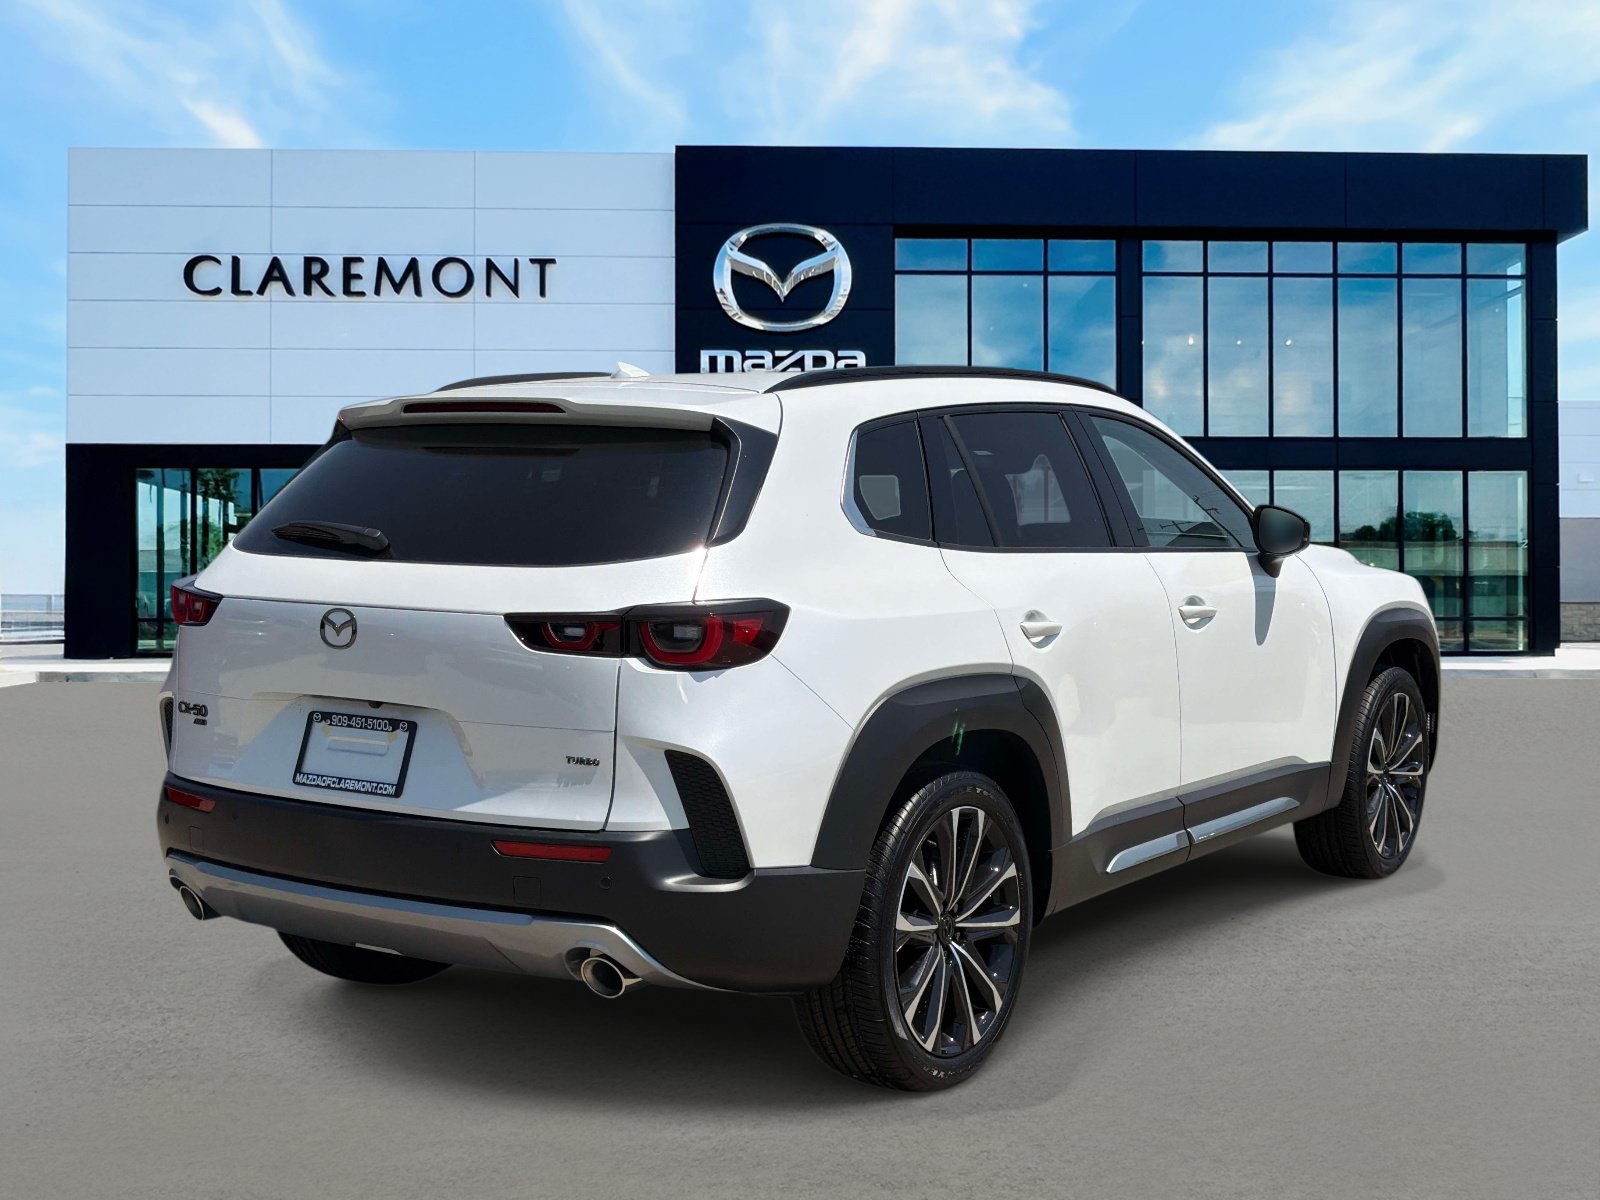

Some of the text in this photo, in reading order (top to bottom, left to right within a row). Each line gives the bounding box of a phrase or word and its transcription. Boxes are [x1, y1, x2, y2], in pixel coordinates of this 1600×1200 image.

[183, 254, 557, 299] CLAREMONT
[331, 714, 390, 731] 909-451-5100
[565, 755, 600, 767] TURBO
[295, 773, 397, 796] MAZDAOFCLAREMONT.COM
